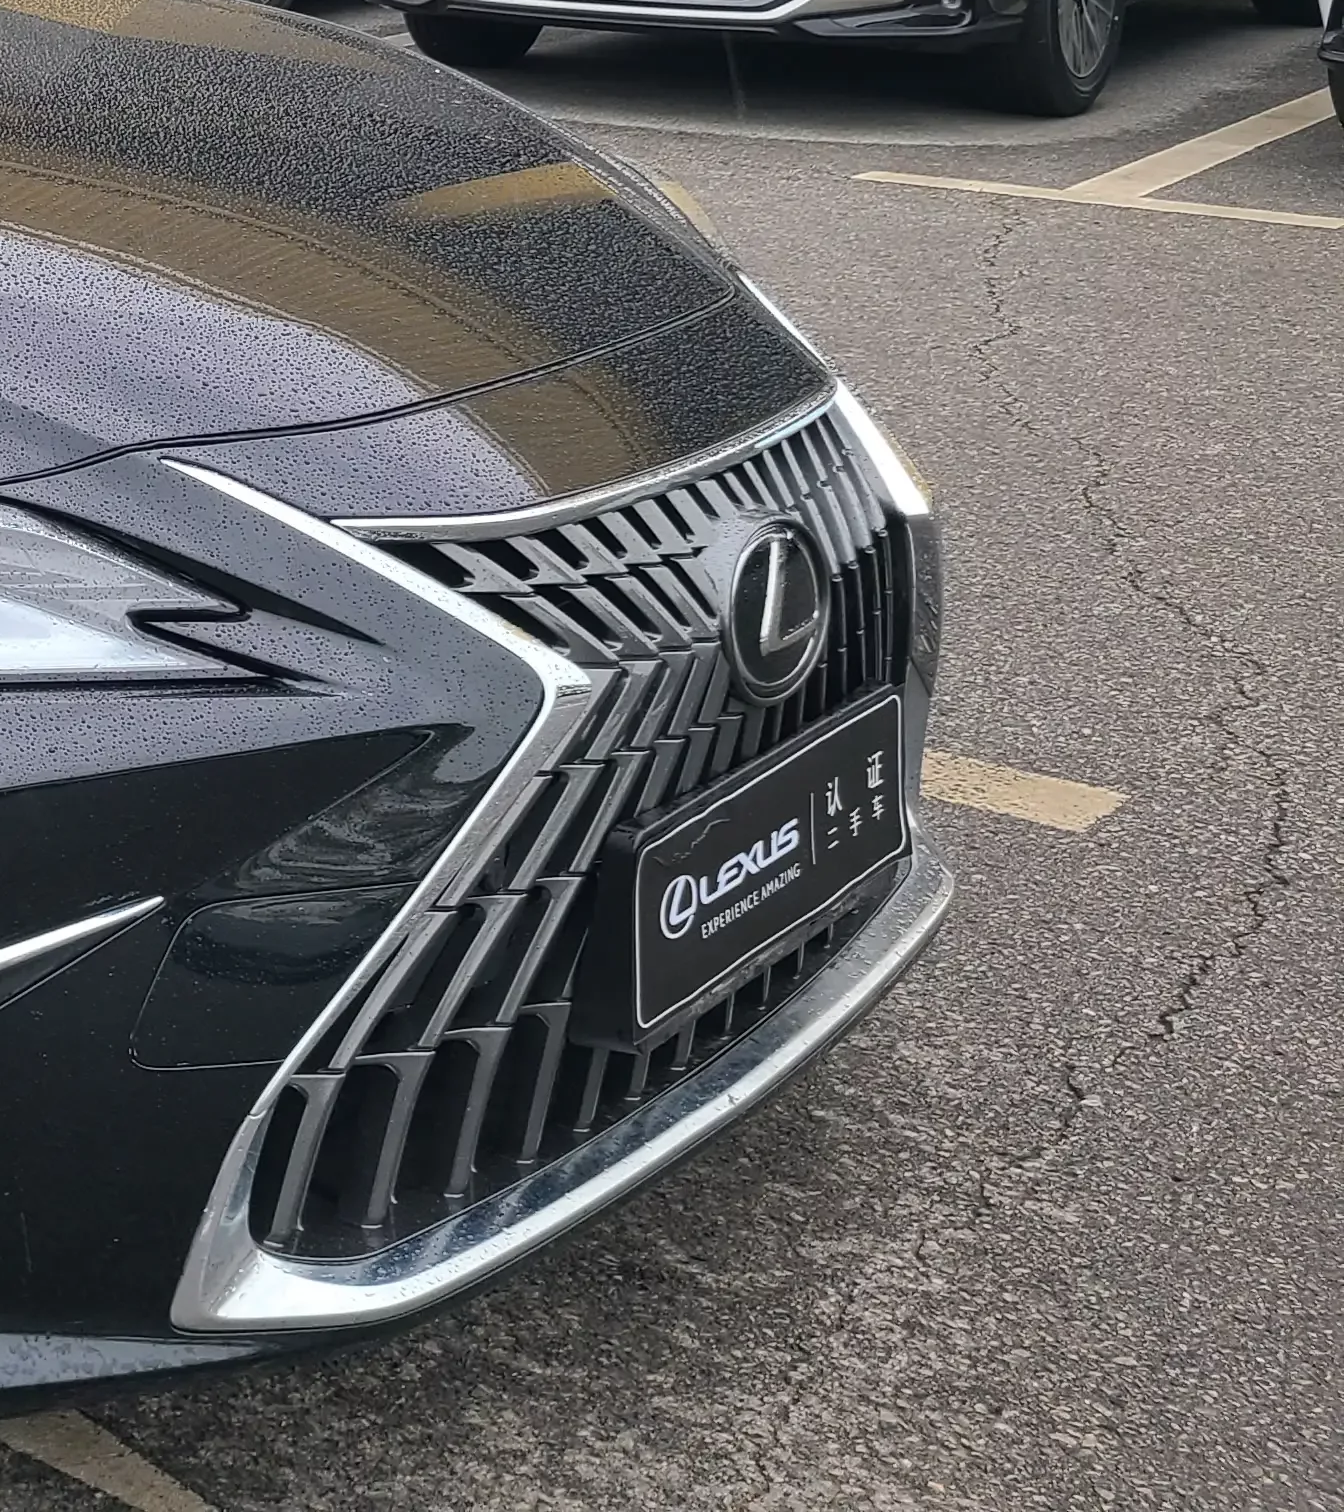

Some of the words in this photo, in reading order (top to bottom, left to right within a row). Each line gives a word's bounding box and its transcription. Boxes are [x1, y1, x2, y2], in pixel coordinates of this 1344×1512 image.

[699, 817, 801, 904] LEXUS
[826, 794, 885, 851] 二手车
[700, 893, 760, 940] EXPERIENCE
[761, 862, 802, 902] AMAZING
